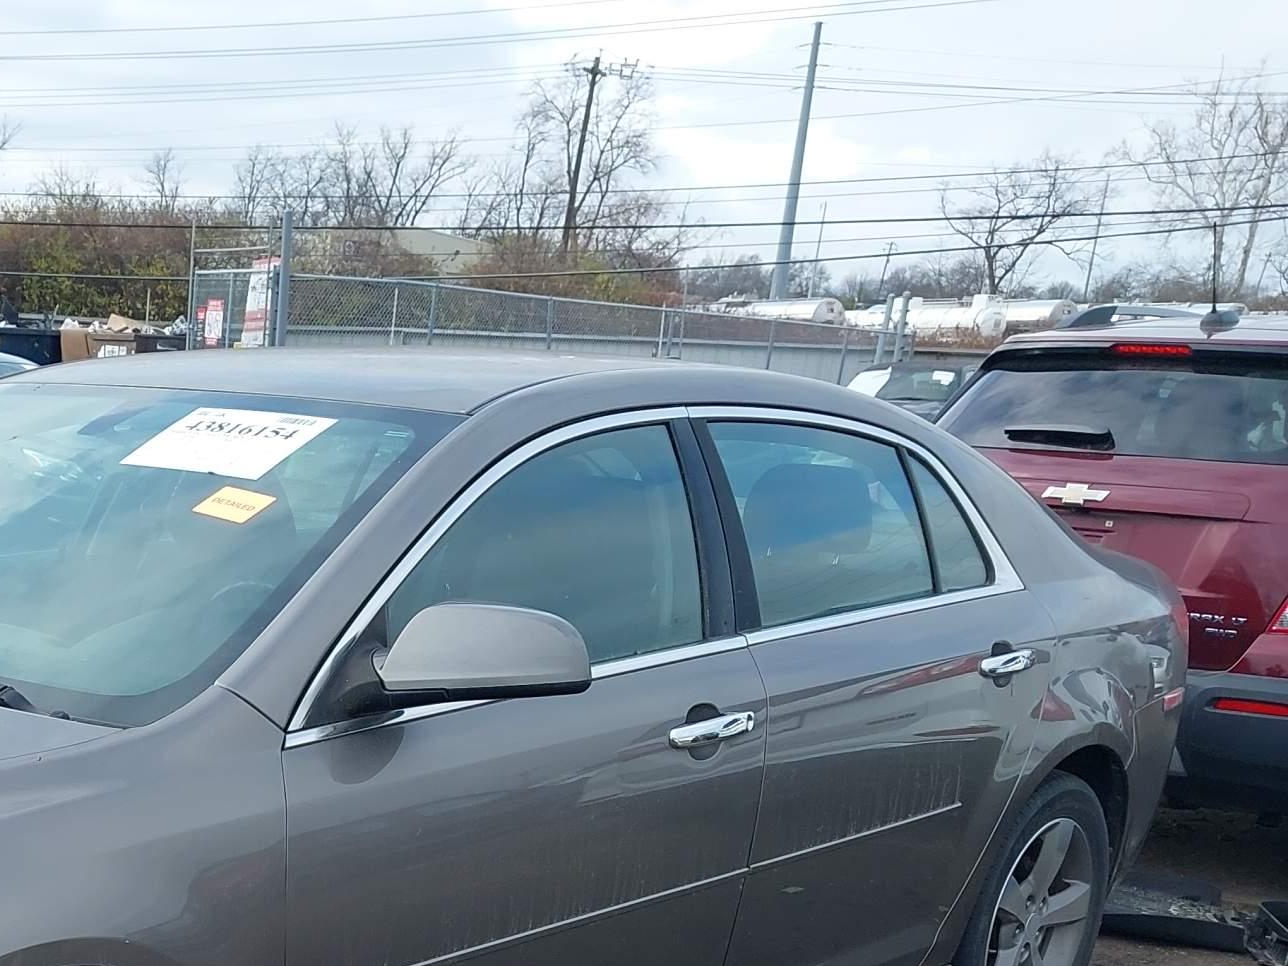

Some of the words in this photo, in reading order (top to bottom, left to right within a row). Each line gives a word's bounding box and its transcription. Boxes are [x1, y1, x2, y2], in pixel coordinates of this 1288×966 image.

[185, 420, 299, 440] 43816154
[211, 497, 255, 511] DETAILED
[1187, 612, 1225, 624] RAX
